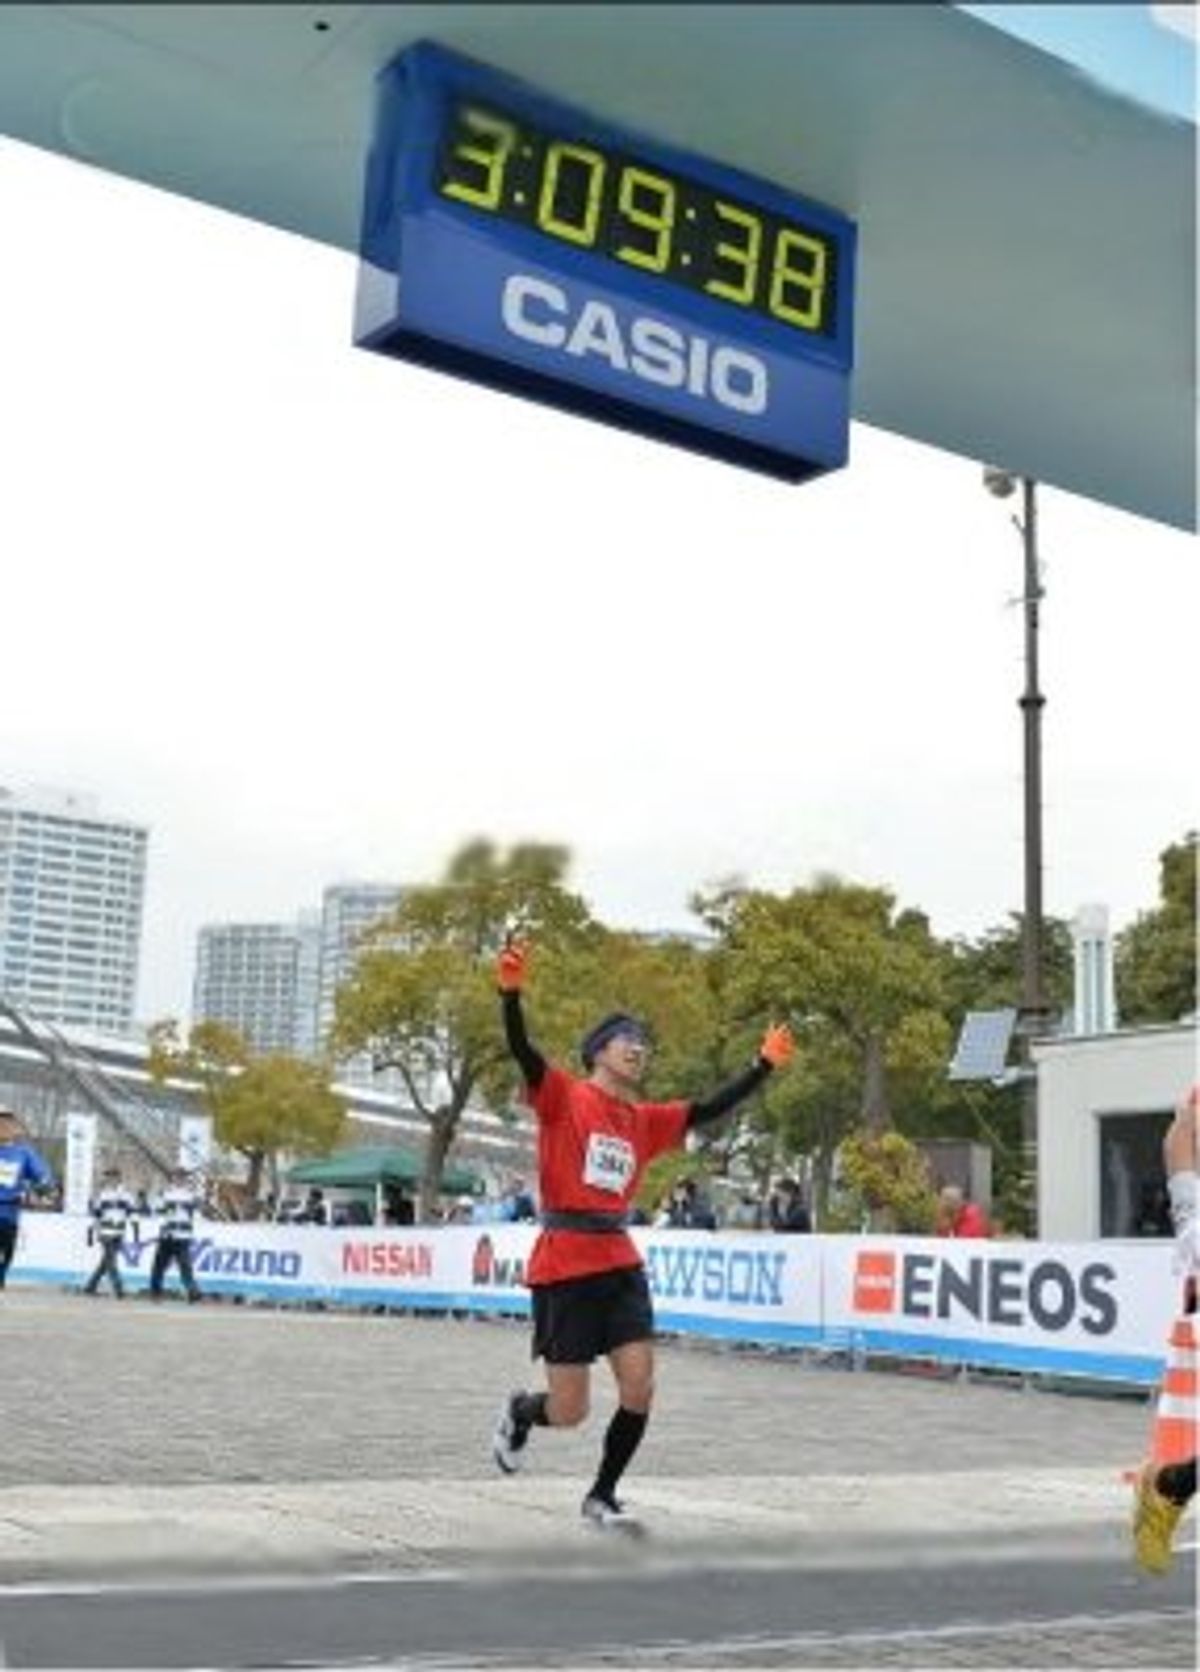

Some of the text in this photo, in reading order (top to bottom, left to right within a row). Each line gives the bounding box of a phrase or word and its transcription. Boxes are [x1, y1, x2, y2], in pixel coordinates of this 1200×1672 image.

[441, 109, 827, 331] 3:09:38
[502, 274, 769, 416] CASIO
[342, 1242, 433, 1278] NISSAN
[647, 1245, 788, 1306] AWSON
[902, 1253, 1118, 1336] ENEOS
